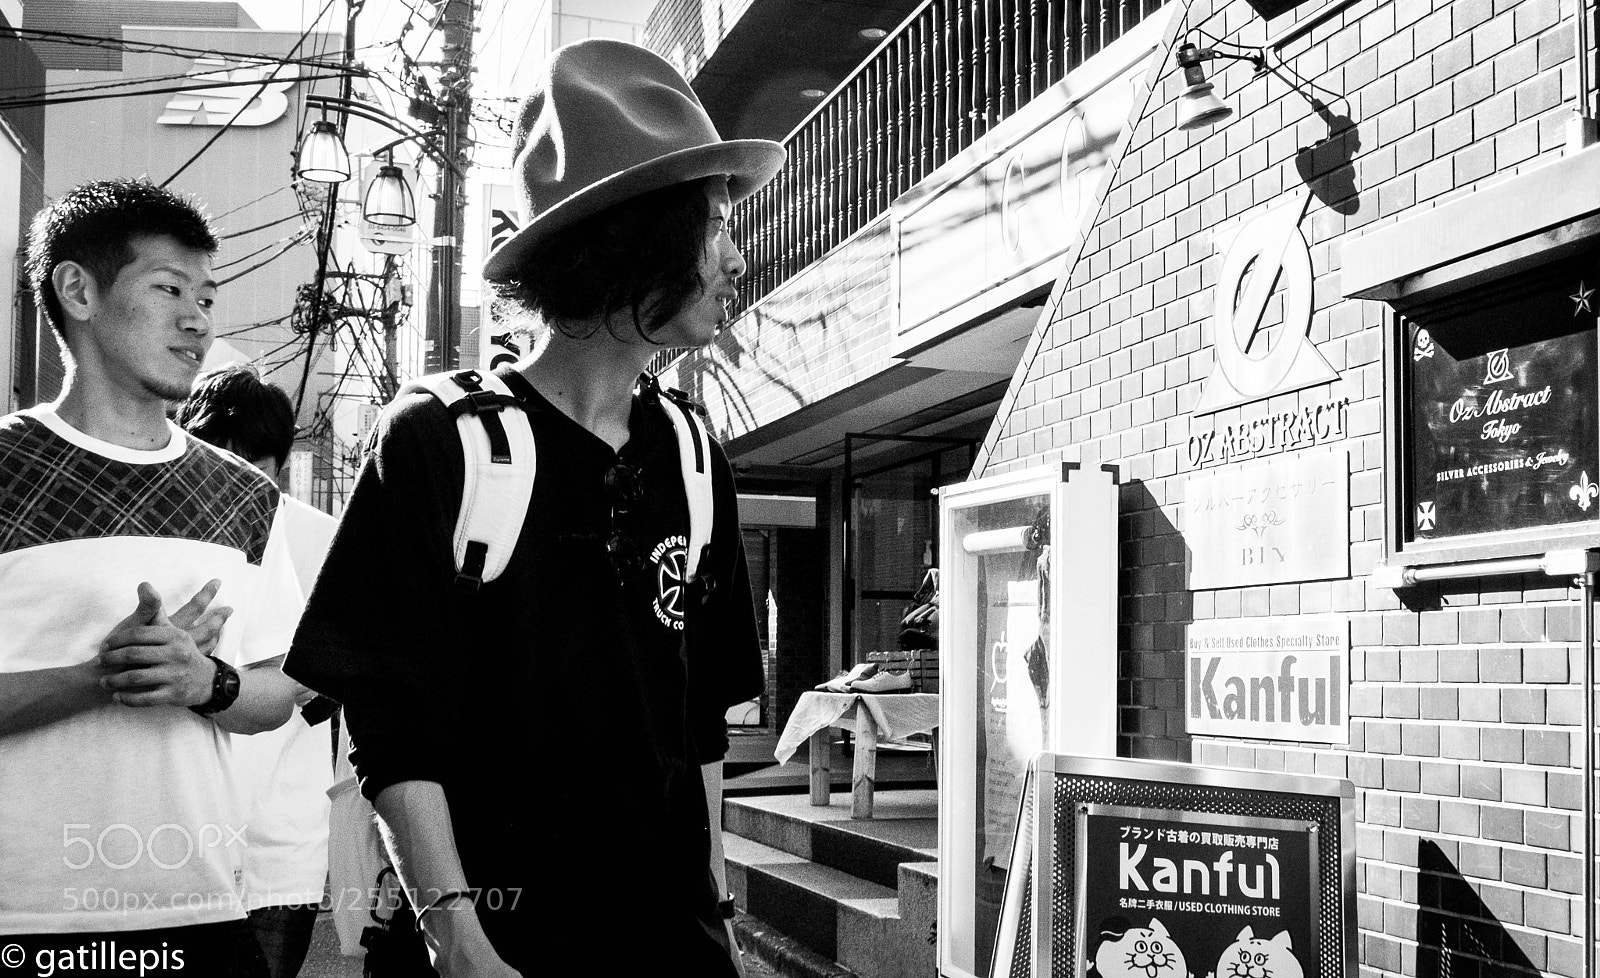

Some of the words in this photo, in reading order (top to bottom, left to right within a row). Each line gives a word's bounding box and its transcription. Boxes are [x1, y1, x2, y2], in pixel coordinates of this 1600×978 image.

[1449, 398, 1474, 424] Oz
[1473, 385, 1552, 418] Abstract
[1188, 430, 1215, 467] OZ
[1218, 398, 1349, 458] ABSTRACT
[1480, 418, 1522, 443] Tokyo
[1436, 469, 1465, 482] SILVER
[1466, 459, 1524, 477] ACCESSORIES
[1524, 456, 1534, 468] &
[652, 597, 672, 628] TRUCK
[673, 620, 684, 630] CO
[1189, 638, 1201, 651] Buy
[1211, 637, 1225, 649] Sell
[1226, 636, 1244, 649] Used
[1245, 635, 1274, 649] Clothes
[1276, 635, 1313, 650] Specialty
[1316, 633, 1340, 647] Store
[1190, 655, 1341, 726] Kanful
[1120, 826, 1279, 851] ブランド古着の買取販売専門店
[1119, 842, 1281, 900] Kanful
[1204, 902, 1251, 916] CLOTHING
[1252, 906, 1281, 917] STORE
